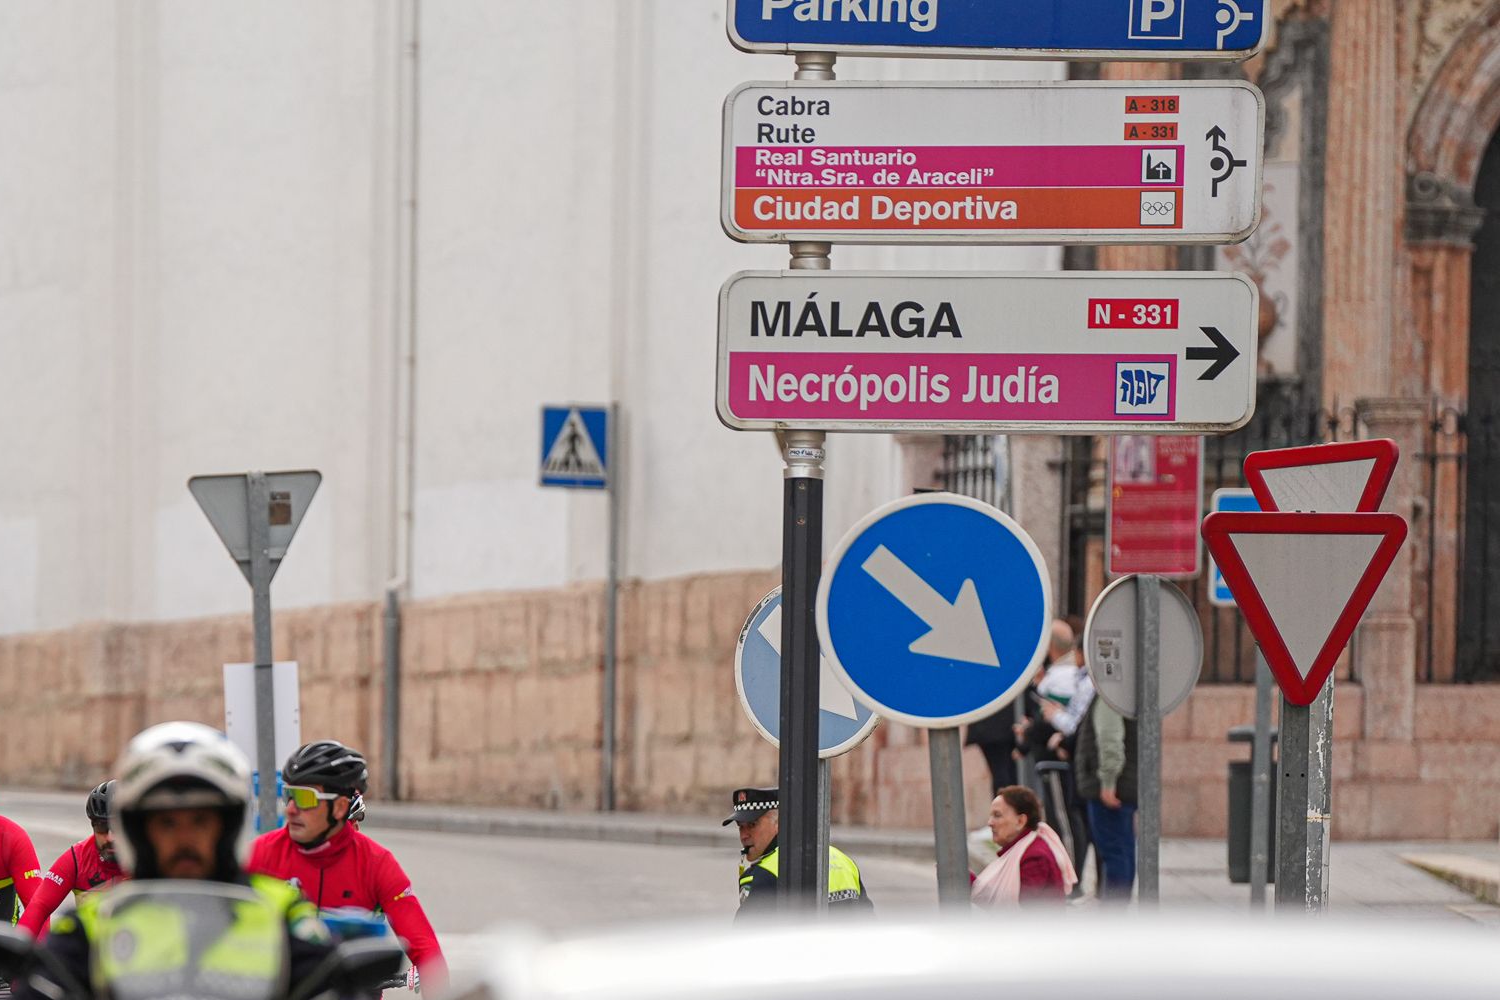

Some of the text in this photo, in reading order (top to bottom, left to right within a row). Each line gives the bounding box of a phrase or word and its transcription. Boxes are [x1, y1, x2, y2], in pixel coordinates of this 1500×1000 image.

[762, 0, 938, 32] Parking
[757, 95, 830, 116] Cabra
[757, 122, 815, 143] Rute
[755, 149, 916, 166] Real Santuario
[873, 168, 900, 185] de
[907, 168, 994, 185] Araceli”
[753, 195, 1018, 225] Ciudad Deportiva
[750, 291, 963, 338] MÁLAGA
[748, 364, 1060, 411] Necrópolis Judía
